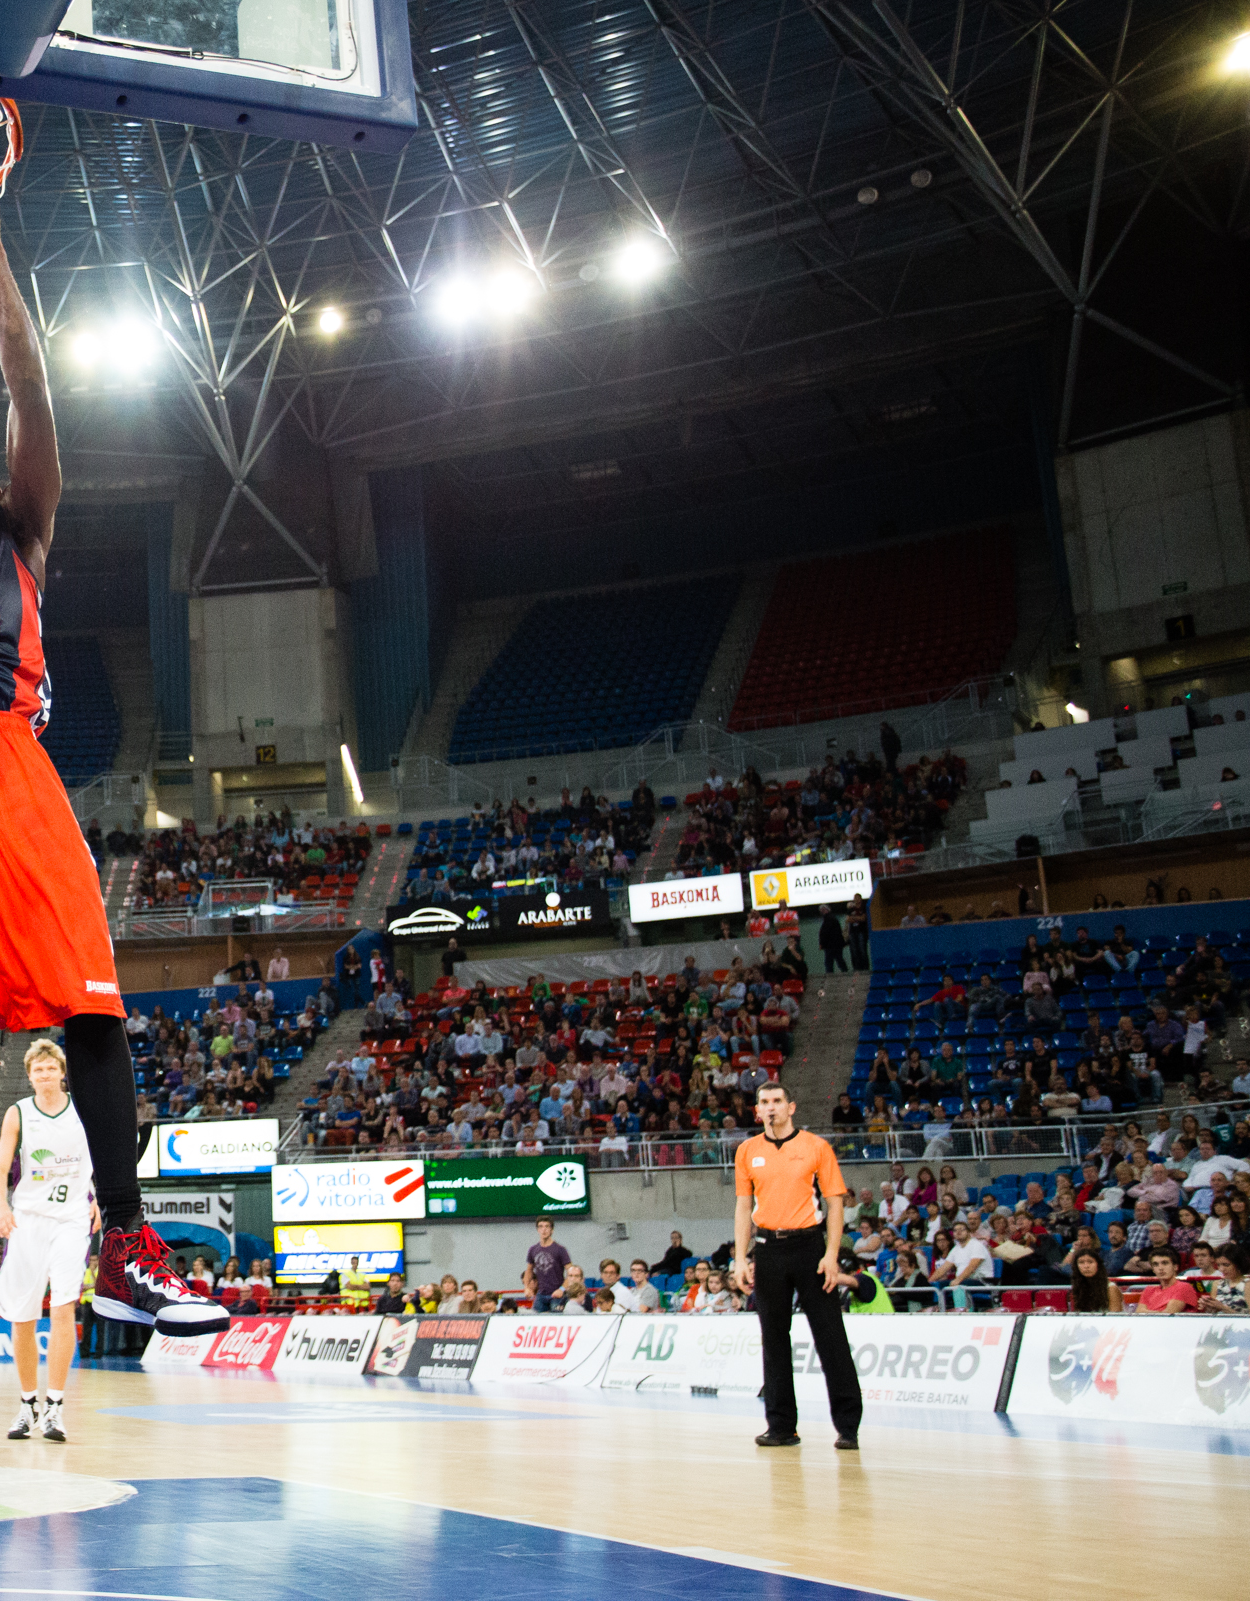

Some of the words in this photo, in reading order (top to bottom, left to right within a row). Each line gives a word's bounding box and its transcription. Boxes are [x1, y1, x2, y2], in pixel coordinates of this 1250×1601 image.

[258, 745, 276, 763] 12
[794, 870, 864, 889] ARABAUTO
[651, 884, 721, 909] BASKONIA
[517, 905, 593, 925] ARABARTE
[1036, 916, 1063, 930] 224
[200, 1141, 273, 1155] GALDIANO
[316, 1167, 371, 1187] radio
[47, 1184, 69, 1203] 19
[316, 1188, 386, 1208] vitoria
[283, 1252, 400, 1271] MICHELIN
[295, 1327, 370, 1363] hummel
[850, 1342, 981, 1382] ORREO
[502, 1366, 568, 1379] supermercados
[867, 1388, 882, 1401] DE
[884, 1389, 895, 1401] TI
[895, 1390, 925, 1404] ZURE
[926, 1392, 969, 1406] BAITAN
